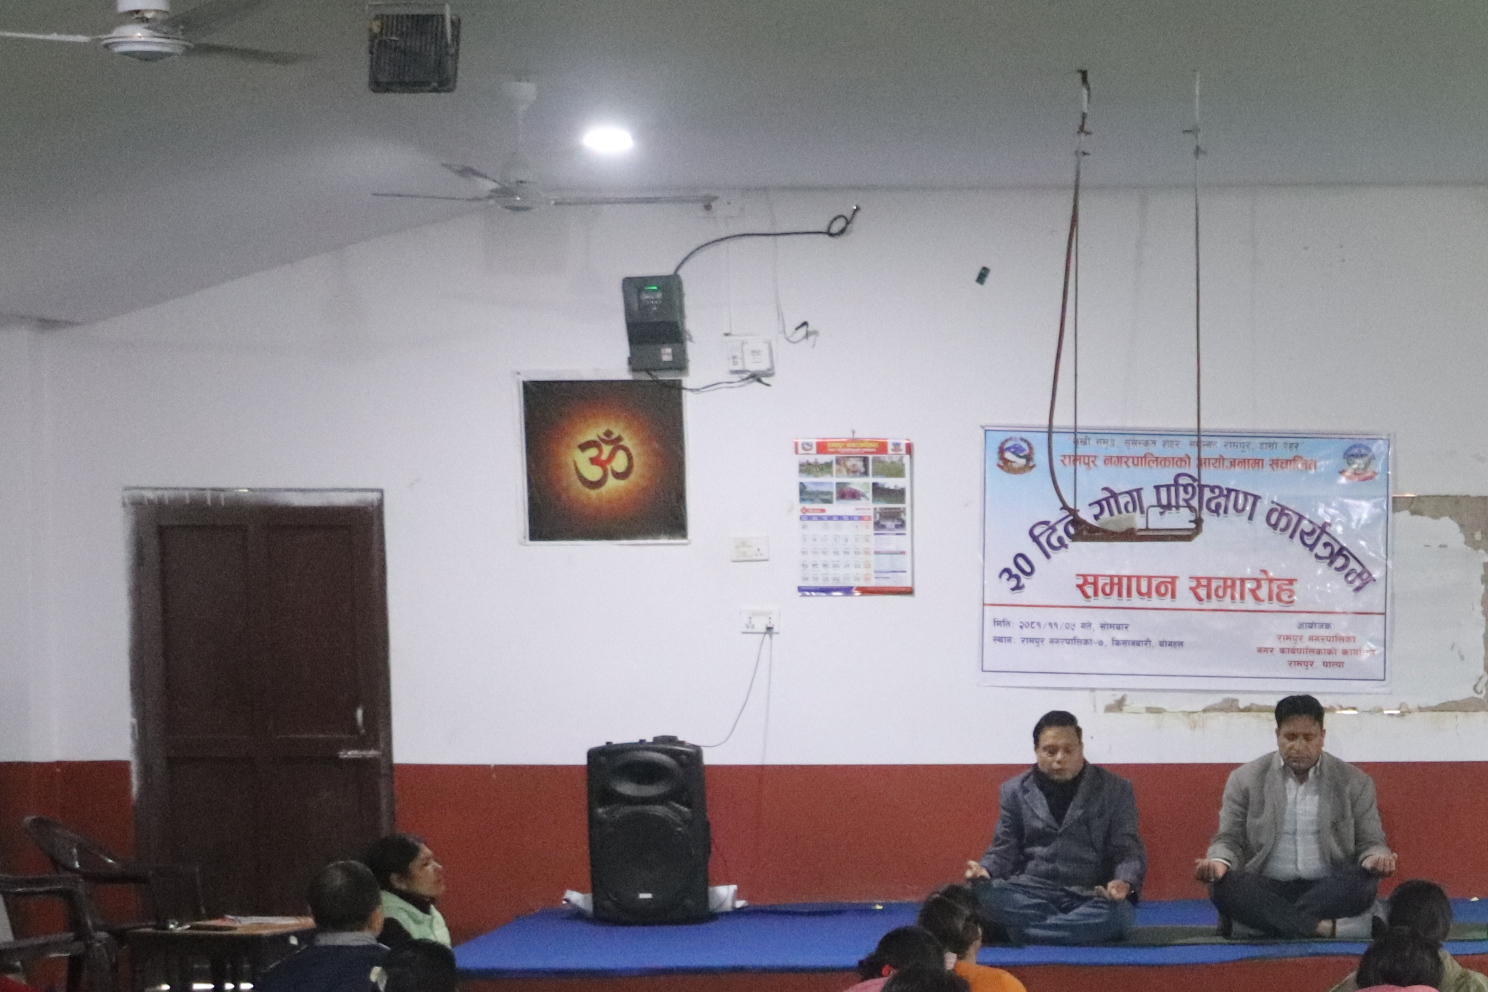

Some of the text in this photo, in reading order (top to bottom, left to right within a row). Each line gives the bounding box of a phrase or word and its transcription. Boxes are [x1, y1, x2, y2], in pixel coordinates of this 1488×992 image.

[1060, 454, 1098, 470] रामपुर
[1103, 452, 1192, 469] नगरपालिकाको
[1197, 454, 1264, 470] आयोजनामा
[998, 552, 1036, 592] ३०
[1153, 472, 1262, 522] प्रशिक्षण
[1265, 500, 1377, 593] कार्यक्रम
[1075, 569, 1298, 605] समापन समारोह
